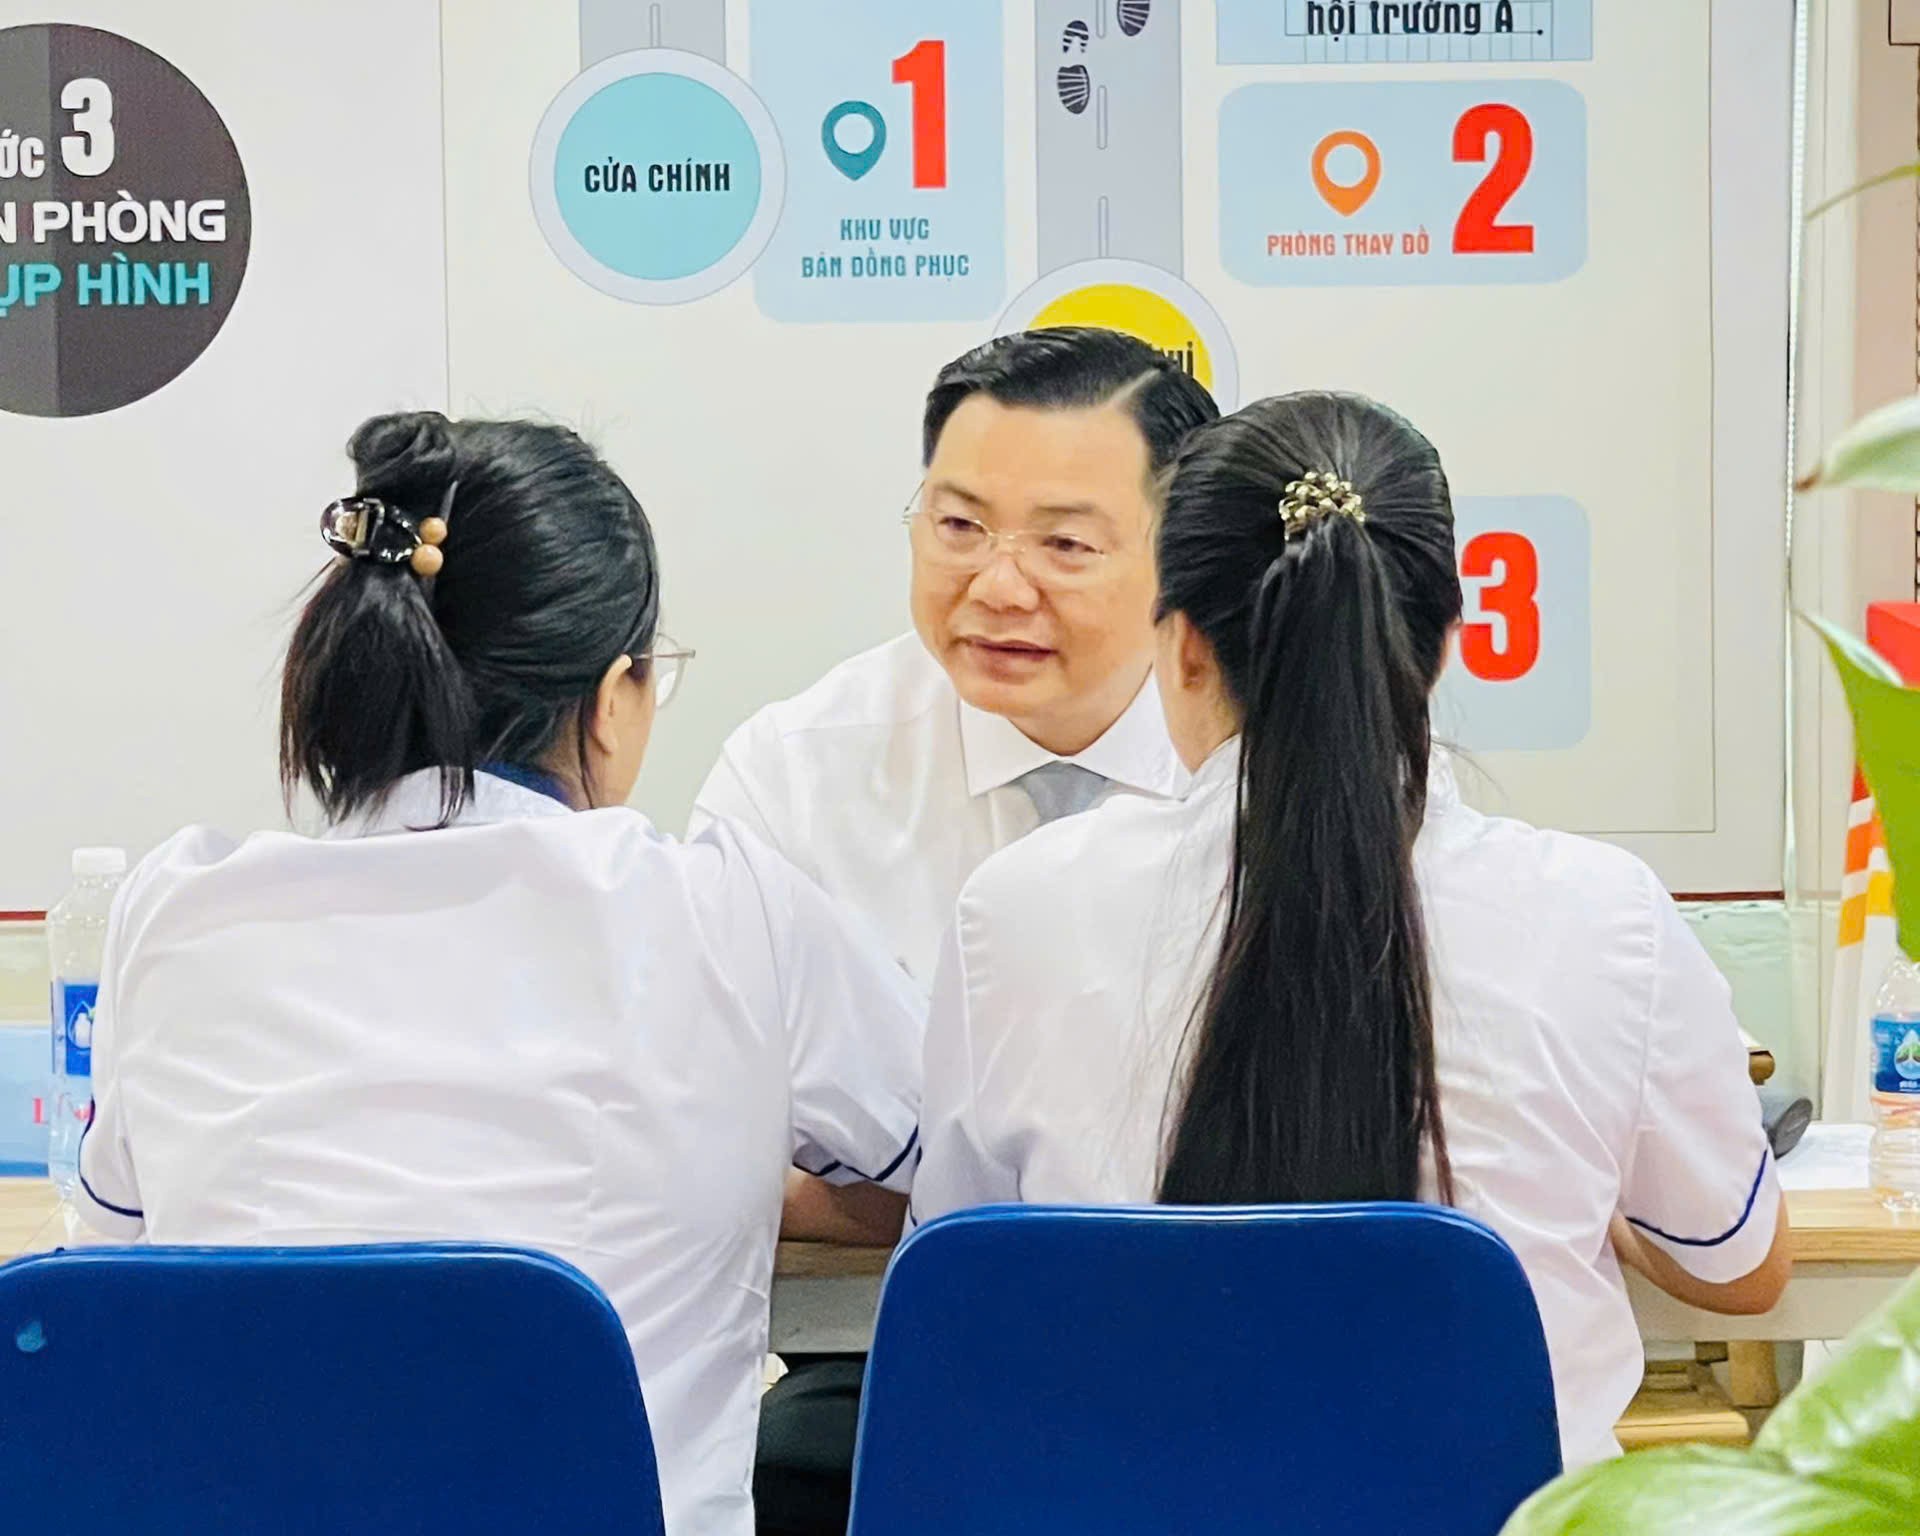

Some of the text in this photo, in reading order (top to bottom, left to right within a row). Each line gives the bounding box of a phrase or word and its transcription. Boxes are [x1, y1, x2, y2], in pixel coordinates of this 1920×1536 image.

[1495, 0, 1513, 33] A
[61, 78, 115, 177] 3
[892, 40, 947, 189] 1
[585, 156, 730, 193] CỬA CHÍNH
[1452, 103, 1534, 254] 2
[33, 190, 226, 243] PHÒNG
[840, 217, 929, 245] KHU VỰC
[1267, 230, 1336, 256] PHÒNG
[1343, 233, 1394, 256] THAY
[78, 252, 210, 305] HÌNH
[915, 254, 969, 282] PHỤC
[1460, 532, 1540, 682] 3
